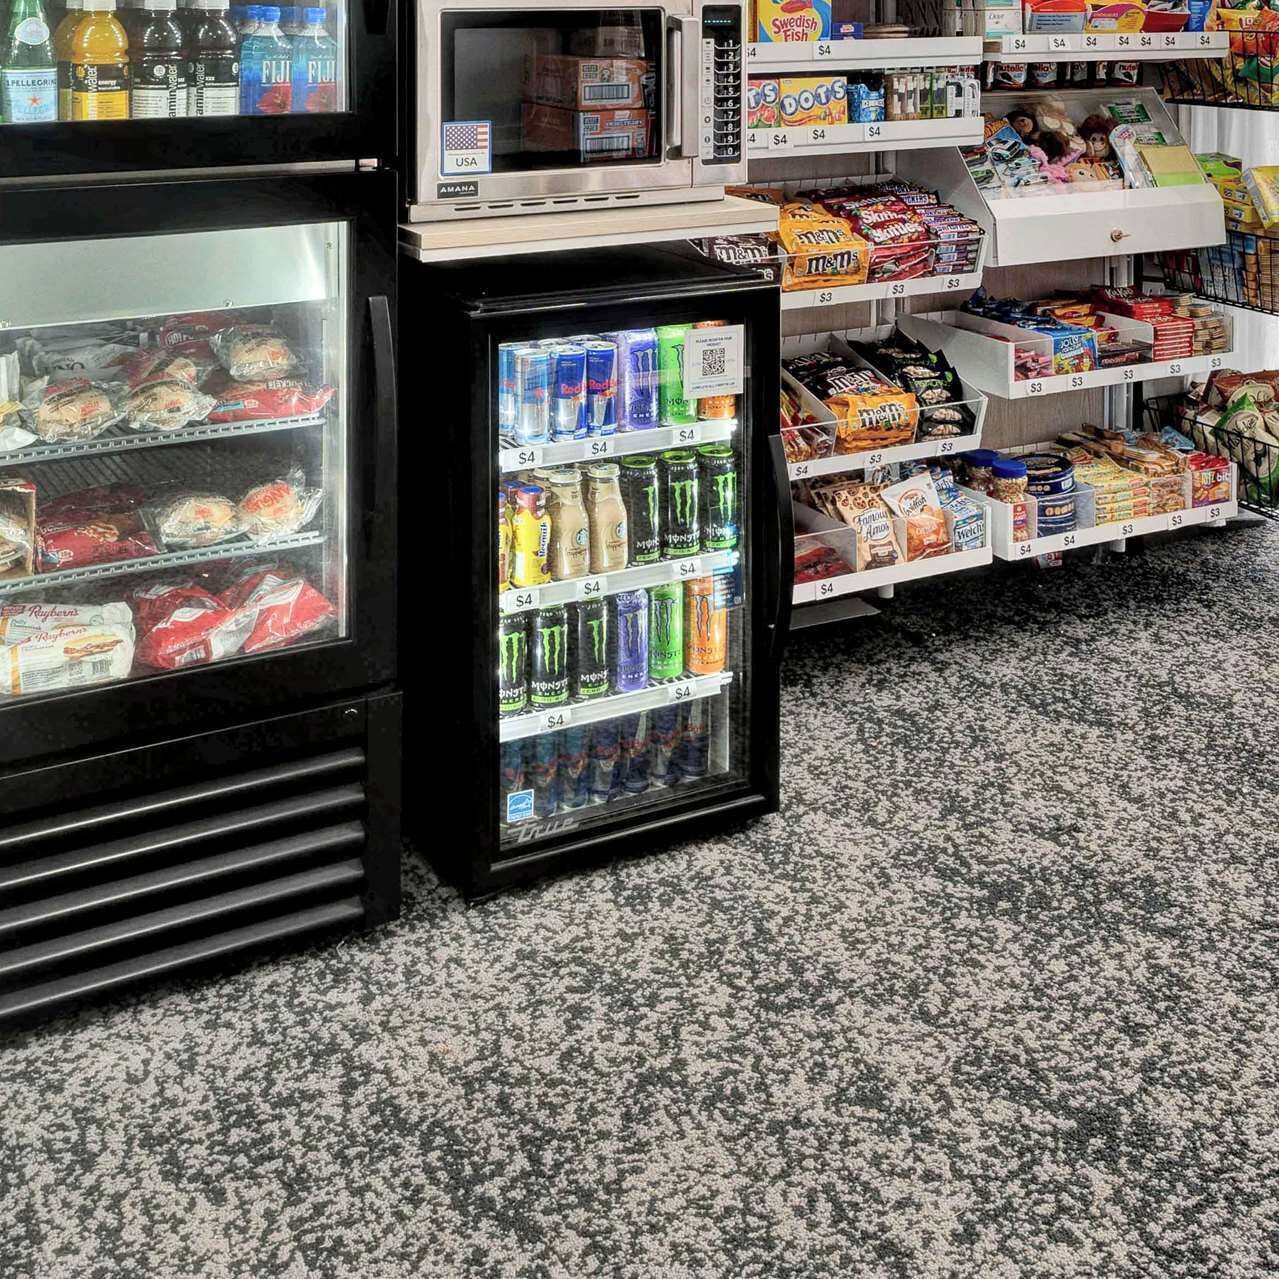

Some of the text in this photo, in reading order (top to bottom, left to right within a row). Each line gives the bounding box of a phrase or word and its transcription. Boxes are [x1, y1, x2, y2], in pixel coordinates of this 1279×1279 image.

[772, 15, 818, 34] Swedish
[783, 29, 807, 41] Fish
[1015, 39, 1026, 49] $4
[1054, 39, 1065, 48] $4
[1086, 37, 1096, 46] $4
[1200, 36, 1210, 45] $4
[818, 45, 830, 55] $4
[262, 60, 289, 83] FIJI
[780, 80, 845, 114] DOTS
[868, 127, 880, 136] $4
[773, 135, 787, 144] $4
[455, 157, 477, 168] USA
[439, 185, 475, 193] AMANA
[947, 279, 959, 288] $3
[892, 284, 904, 294] $3
[820, 292, 832, 302] $3
[1211, 358, 1220, 368] $3
[1170, 364, 1180, 374] $3
[1072, 376, 1083, 387] $3
[1031, 382, 1042, 392] $3
[680, 430, 695, 441] $4
[591, 442, 607, 455] $4
[519, 452, 535, 465] $4
[870, 455, 882, 464] $3
[795, 467, 808, 476] $4
[855, 509, 888, 530] Famous
[1172, 515, 1182, 525] $3
[865, 524, 889, 541] Amos
[957, 520, 984, 540] Welch's
[1064, 536, 1074, 546] $4
[681, 563, 695, 574] $4
[821, 584, 833, 593] $4
[516, 594, 532, 606] $4
[548, 715, 563, 728] $4
